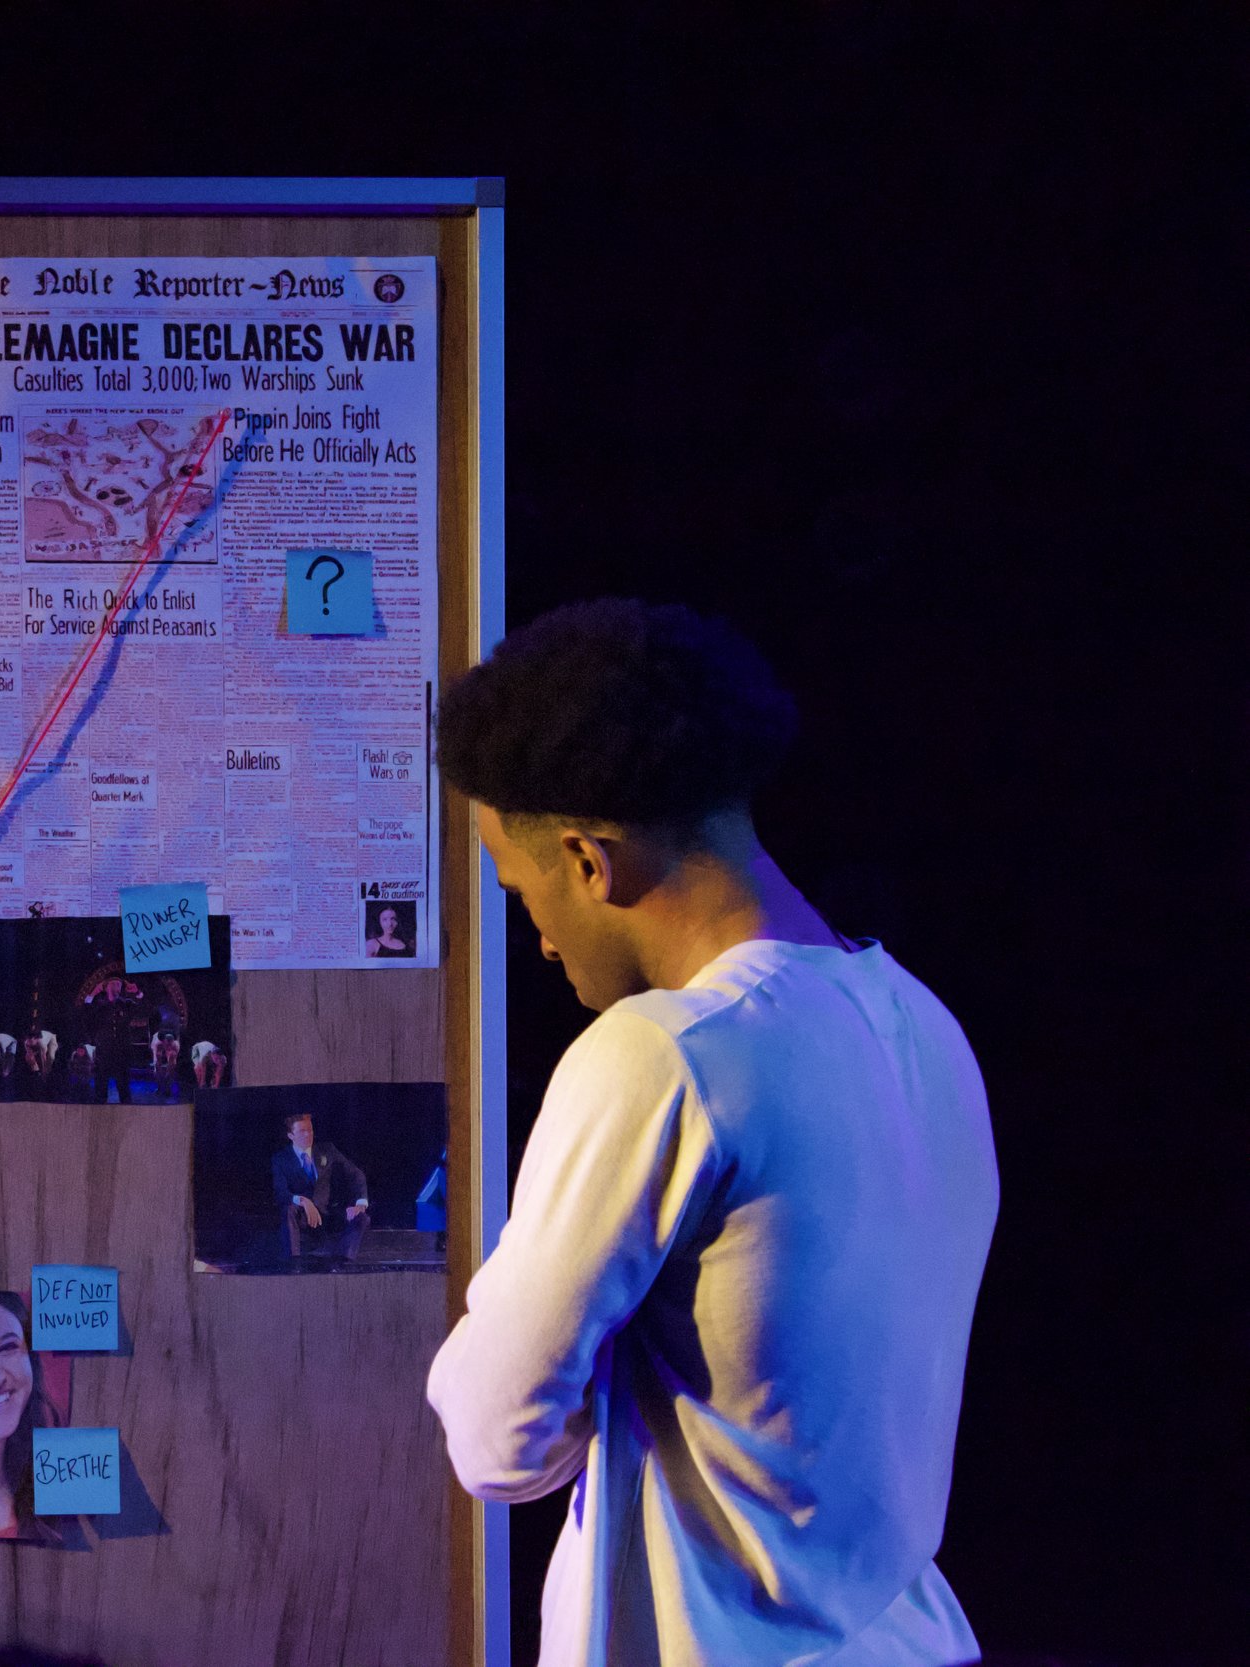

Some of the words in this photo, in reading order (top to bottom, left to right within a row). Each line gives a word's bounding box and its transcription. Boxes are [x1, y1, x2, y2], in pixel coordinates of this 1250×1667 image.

[33, 267, 113, 298] Noble
[163, 322, 324, 362] DECLARES
[340, 322, 415, 362] WAR
[14, 366, 83, 393] Casulties
[94, 366, 131, 392] Total
[201, 366, 232, 391] Two
[242, 366, 316, 394] Warships
[326, 365, 364, 391] Sunk
[234, 407, 288, 435] Pippin
[293, 405, 331, 430] Joins
[342, 405, 381, 433] Fight
[223, 437, 274, 464] Before
[280, 438, 305, 463] He
[313, 437, 379, 467] Officially
[385, 438, 417, 463] Acts
[306, 555, 344, 616] ?
[28, 587, 53, 609] The
[64, 588, 97, 610] Rich
[104, 589, 139, 611] Quick
[145, 592, 158, 610] to
[163, 589, 195, 610] Enlist
[25, 615, 45, 635] For
[50, 615, 95, 636] Service
[101, 615, 150, 638] Against
[153, 617, 217, 638] Peasants
[226, 750, 281, 771] Bulletins
[363, 748, 389, 764] Flash!
[370, 764, 394, 780] Wars
[397, 768, 409, 780] on
[91, 791, 121, 802] Quarter
[123, 791, 145, 802] Mark
[361, 881, 380, 899] 14
[381, 889, 390, 899] To
[391, 889, 425, 899] audition
[125, 898, 195, 937] POWER
[130, 919, 200, 962] HUNGRY
[232, 928, 240, 937] He
[38, 1277, 77, 1304] DEF
[81, 1283, 113, 1303] NOT
[40, 1310, 109, 1330] INVOLVED
[35, 1449, 112, 1485] BERTHE
